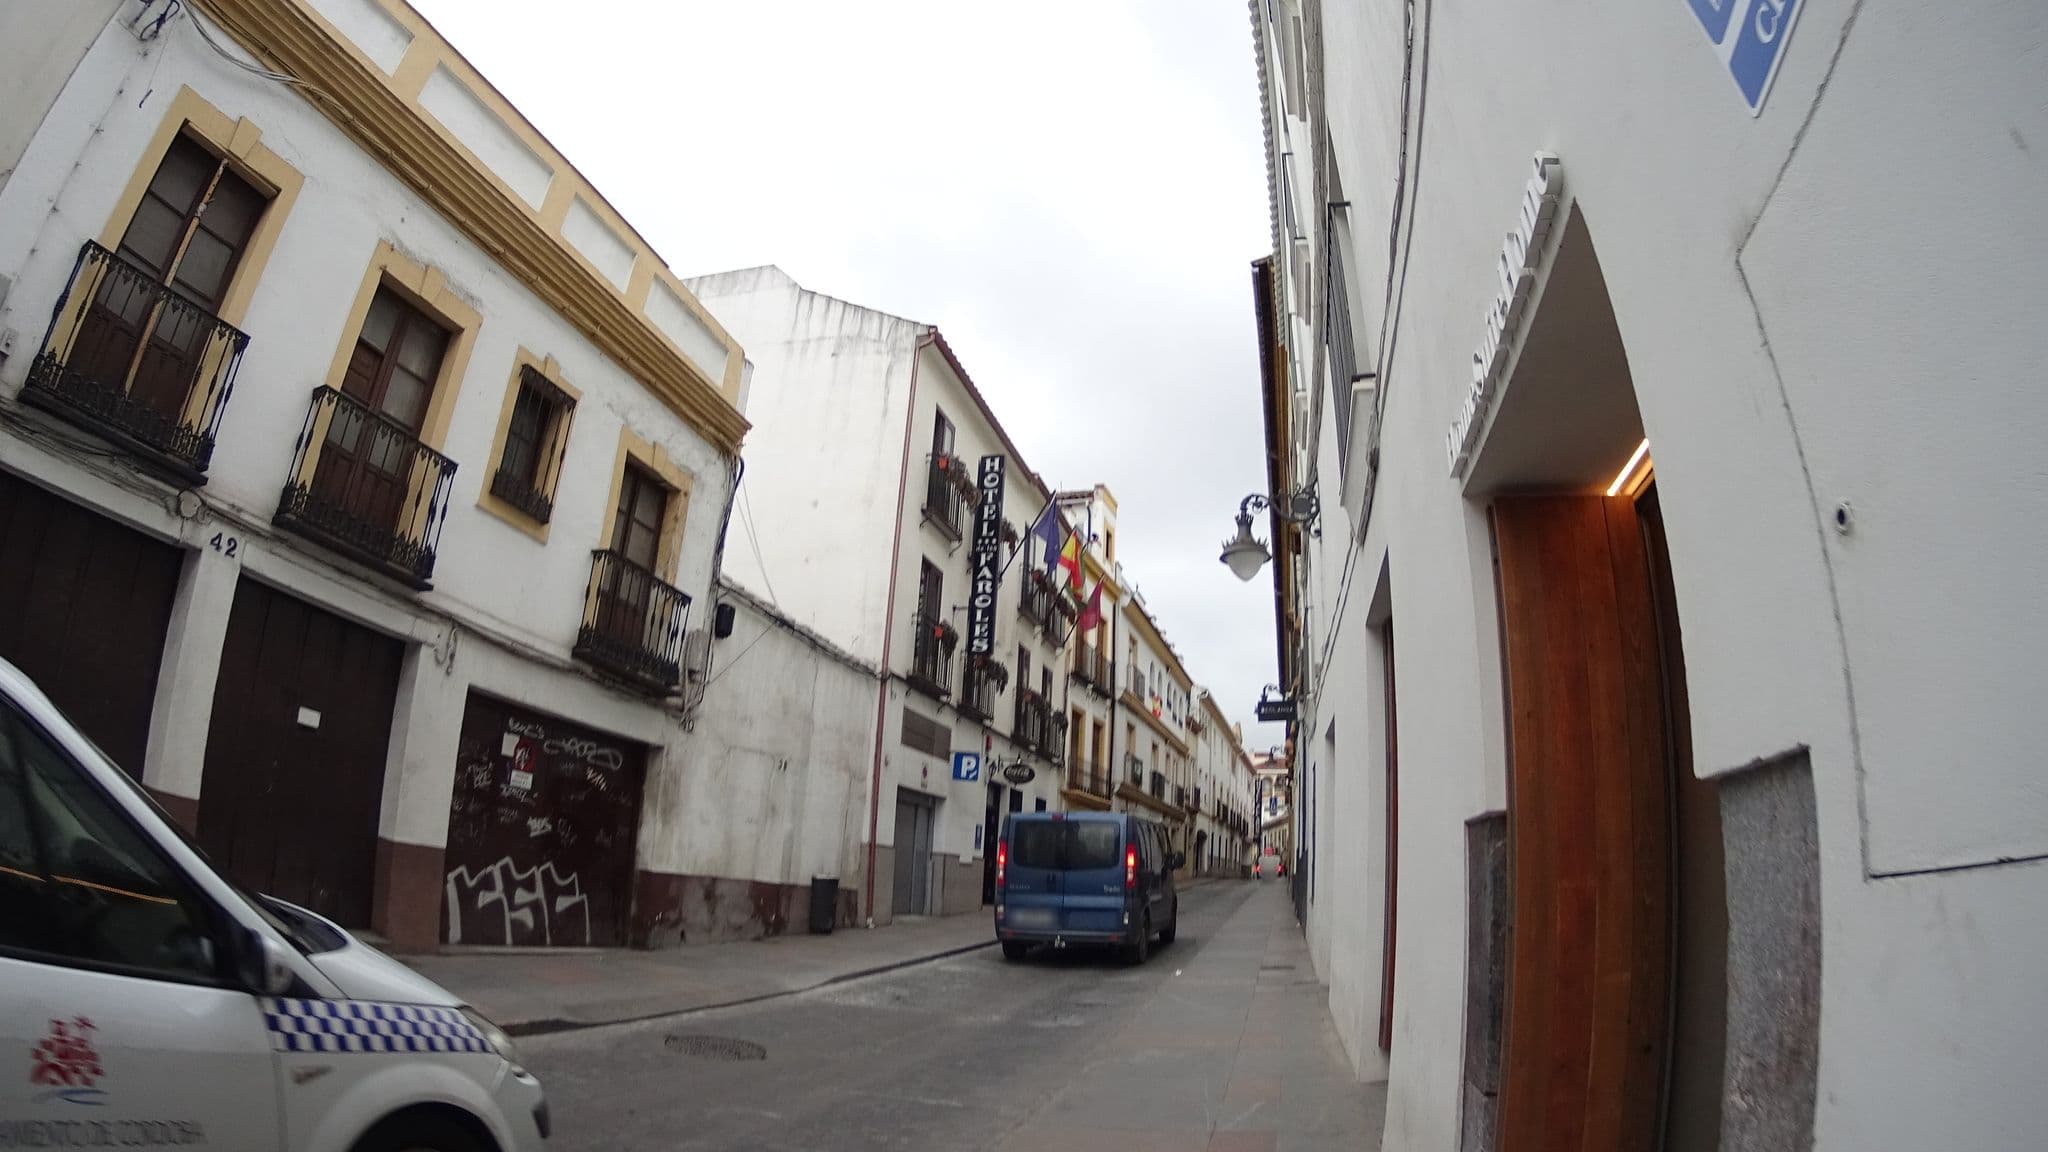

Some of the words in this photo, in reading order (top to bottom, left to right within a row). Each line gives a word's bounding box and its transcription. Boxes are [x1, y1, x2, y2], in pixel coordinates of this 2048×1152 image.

[982, 456, 1000, 537] HOTEL
[209, 532, 238, 558] 42
[971, 552, 994, 653] FAROLES
